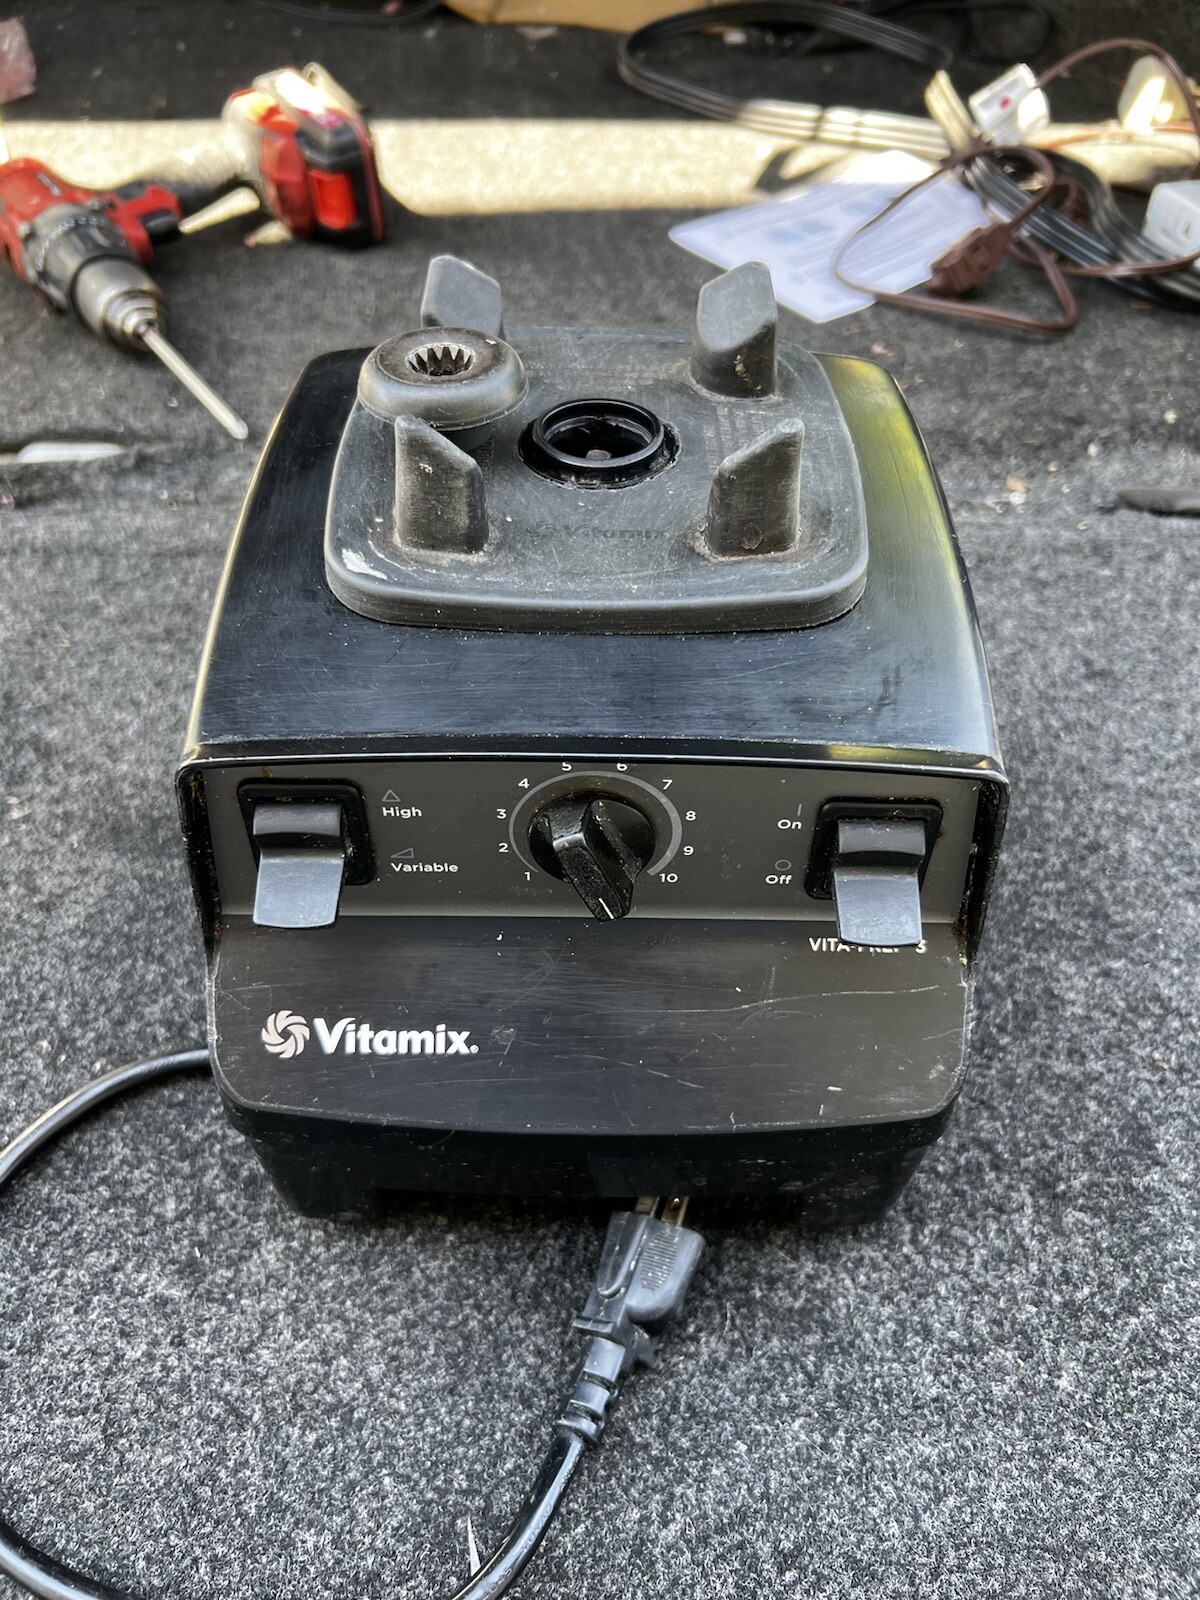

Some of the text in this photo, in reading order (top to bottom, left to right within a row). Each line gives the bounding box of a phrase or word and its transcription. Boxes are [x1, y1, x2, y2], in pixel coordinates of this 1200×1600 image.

[561, 762, 572, 772] 5
[616, 762, 628, 772] 6
[517, 778, 530, 789] 4
[662, 779, 673, 790] 7
[381, 806, 423, 819] High
[496, 808, 507, 819] 3
[685, 811, 696, 821] 8
[777, 818, 802, 830] On
[498, 843, 509, 853] 2
[683, 846, 694, 856] 9
[390, 862, 459, 873] Variable
[524, 872, 531, 881] 1
[659, 873, 679, 883] 10
[765, 875, 793, 885] Off
